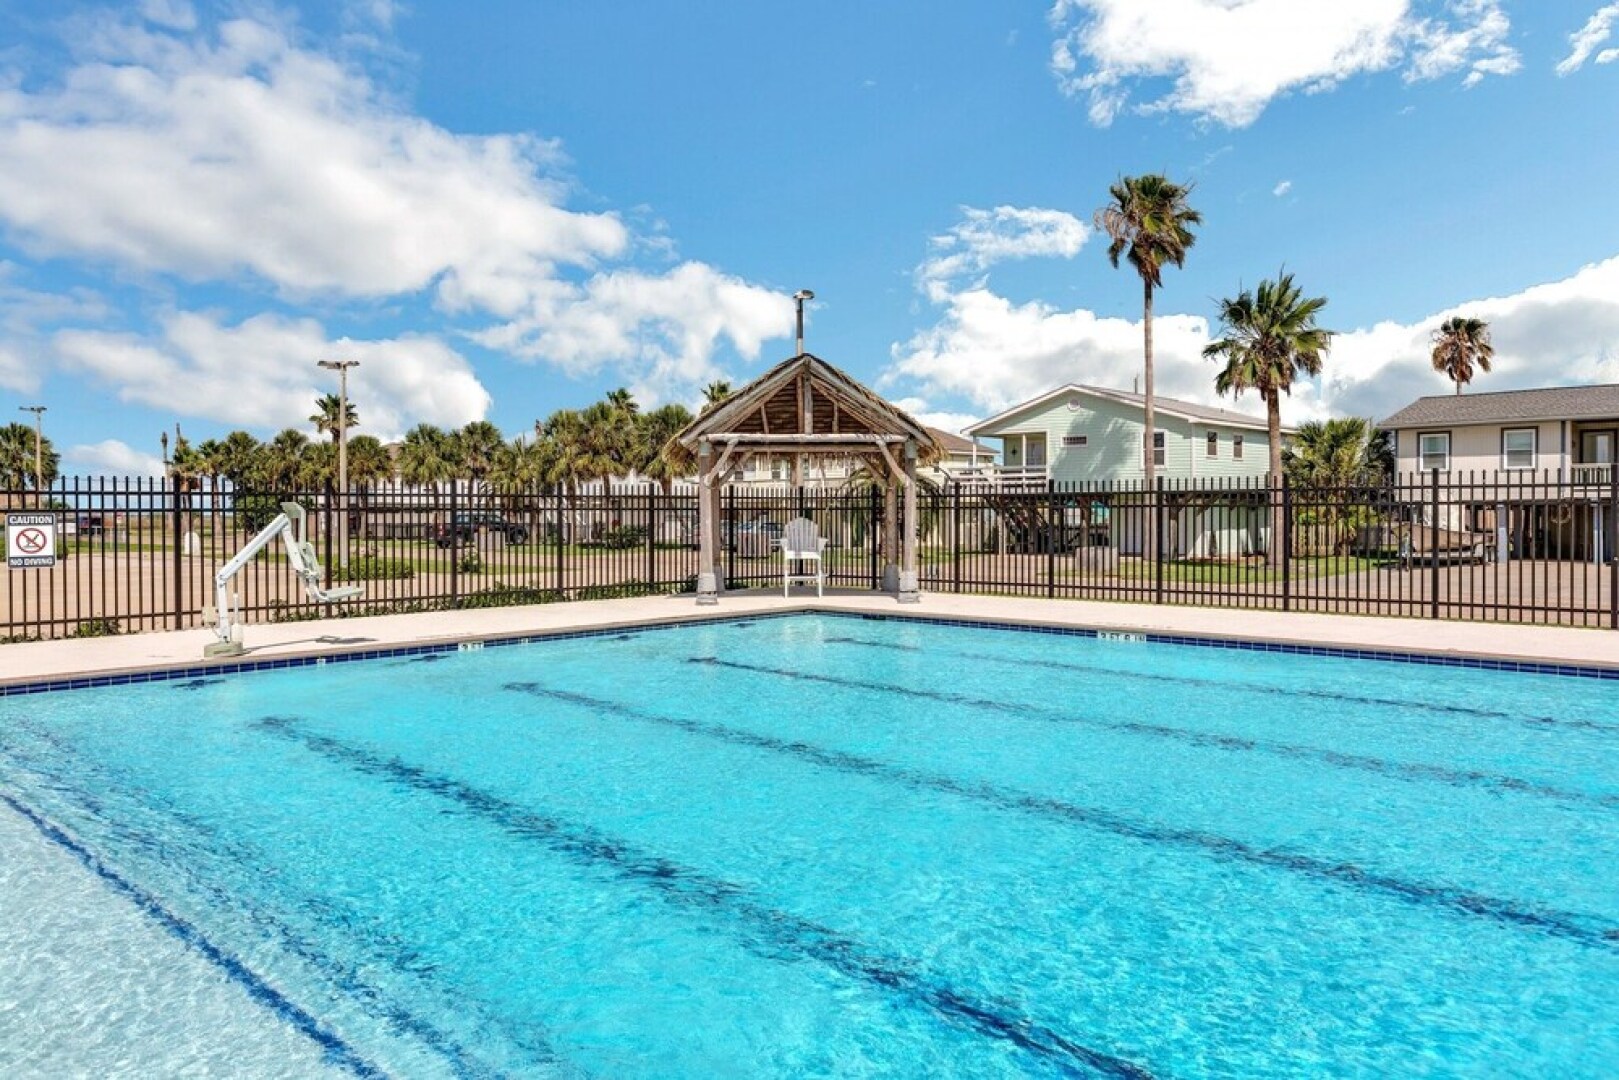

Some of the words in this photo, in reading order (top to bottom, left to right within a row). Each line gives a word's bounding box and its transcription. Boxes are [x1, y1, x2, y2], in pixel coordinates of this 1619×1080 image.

[9, 516, 53, 524] CAUTION
[10, 558, 23, 566] NO
[24, 558, 53, 566] DIVING
